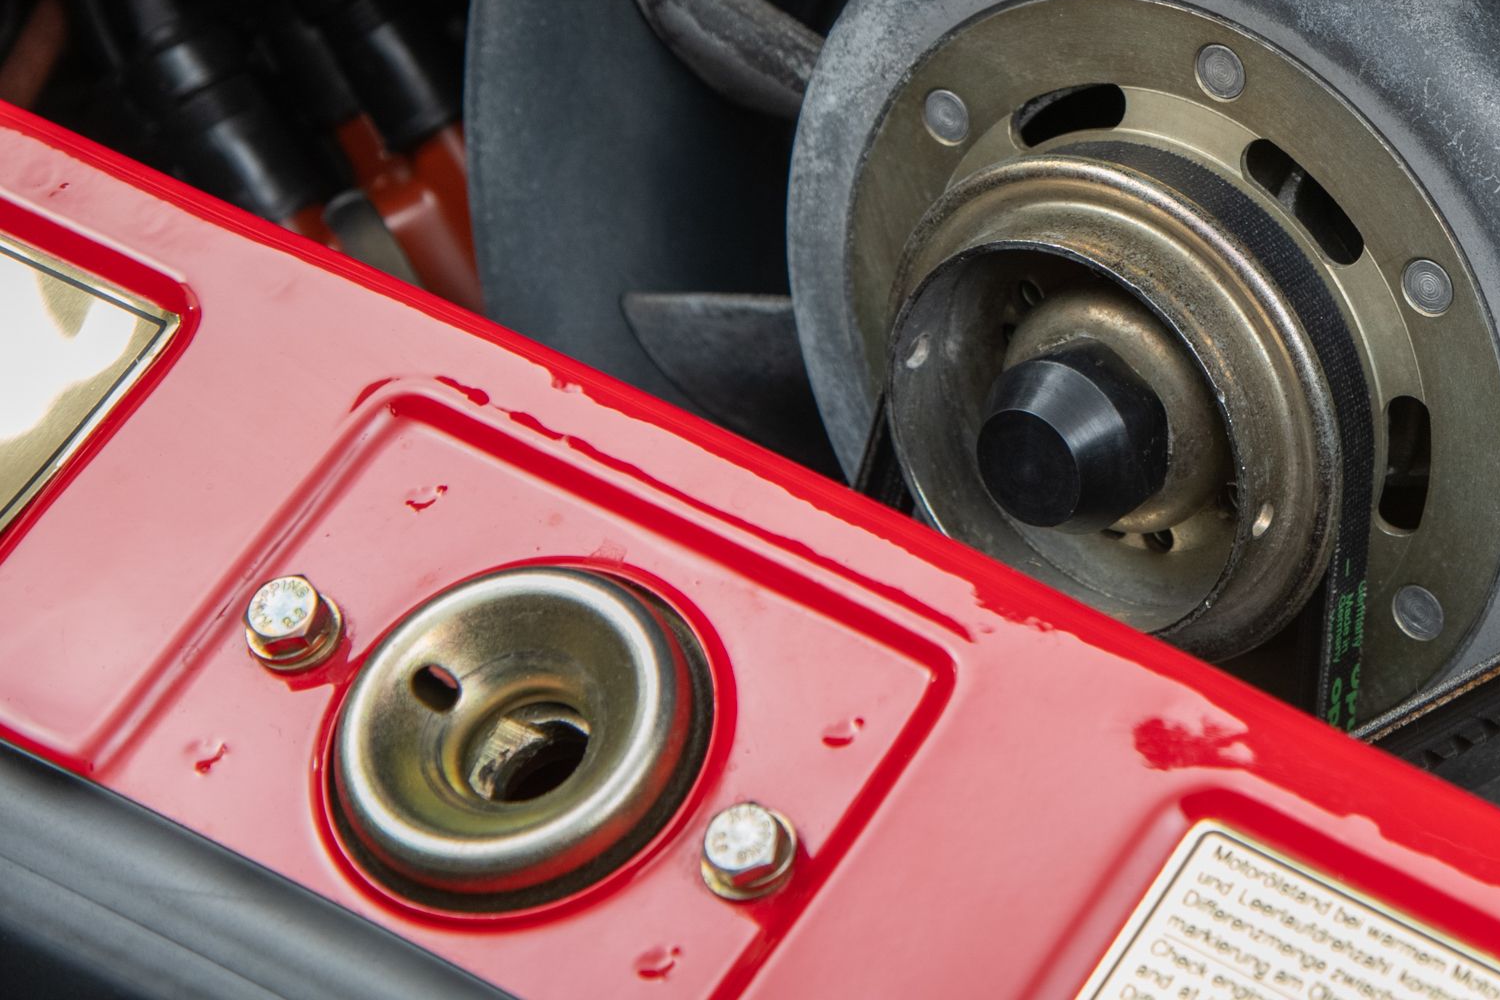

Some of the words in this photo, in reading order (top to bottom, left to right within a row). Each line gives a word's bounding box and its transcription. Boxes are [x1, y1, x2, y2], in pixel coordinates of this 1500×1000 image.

[1182, 889, 1327, 972] Differenzmenge
[1197, 871, 1234, 895] und
[1237, 889, 1394, 975] Leerlaufdrehzahl
[1213, 845, 1331, 916] Motorölstand
[1333, 907, 1363, 929] bei
[1367, 925, 1447, 970] warmem
[1135, 964, 1174, 990] and
[1150, 938, 1207, 977] Check
[1167, 914, 1270, 982] markierung
[1273, 970, 1304, 991] am
